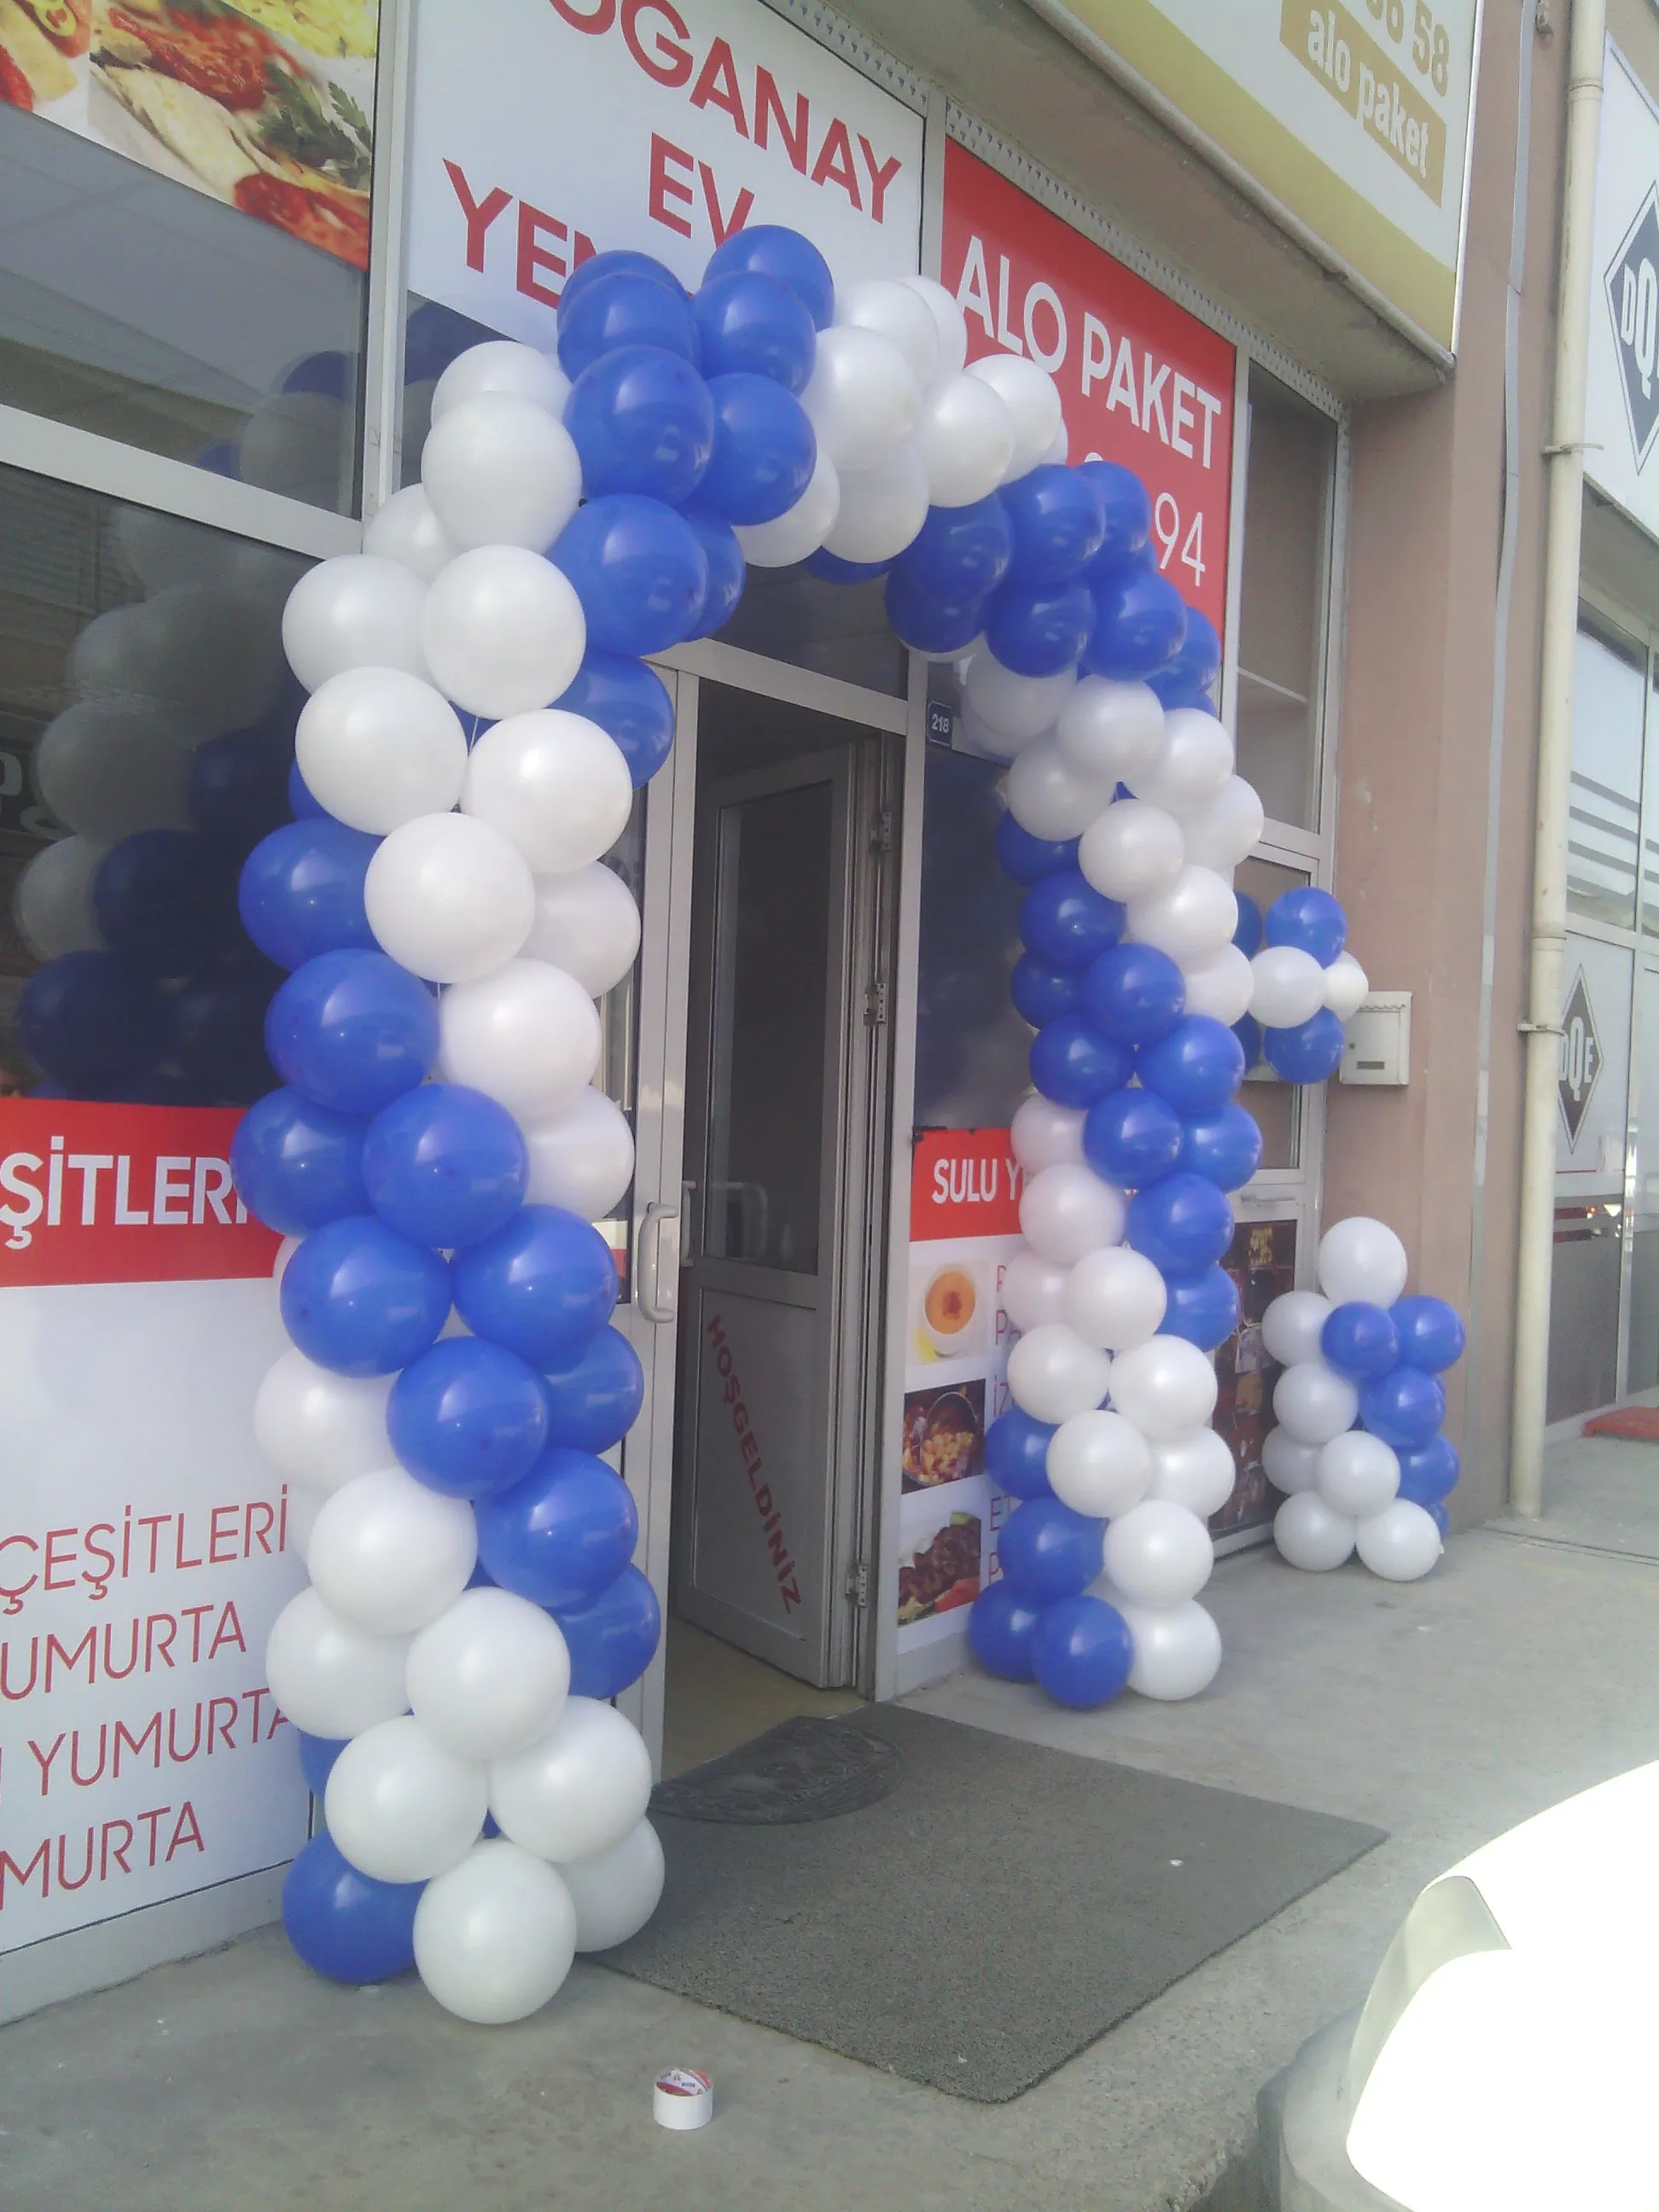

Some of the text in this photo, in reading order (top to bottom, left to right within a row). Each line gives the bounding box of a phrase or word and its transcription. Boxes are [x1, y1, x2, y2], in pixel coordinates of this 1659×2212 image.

[1307, 9, 1429, 178] alo paket
[1413, 0, 1449, 96] 58
[441, 158, 597, 311] YE
[649, 131, 754, 248] EV
[956, 236, 1222, 469] ALO PAKET
[1621, 258, 1659, 399] DQ
[1155, 492, 1206, 587] 94
[931, 713, 950, 733] 218
[932, 1158, 998, 1204] SULU
[0, 1484, 288, 1615] ÇEŞİTLERİ
[1, 1601, 247, 1701] UMURTA
[0, 1801, 205, 1910] MURTA
